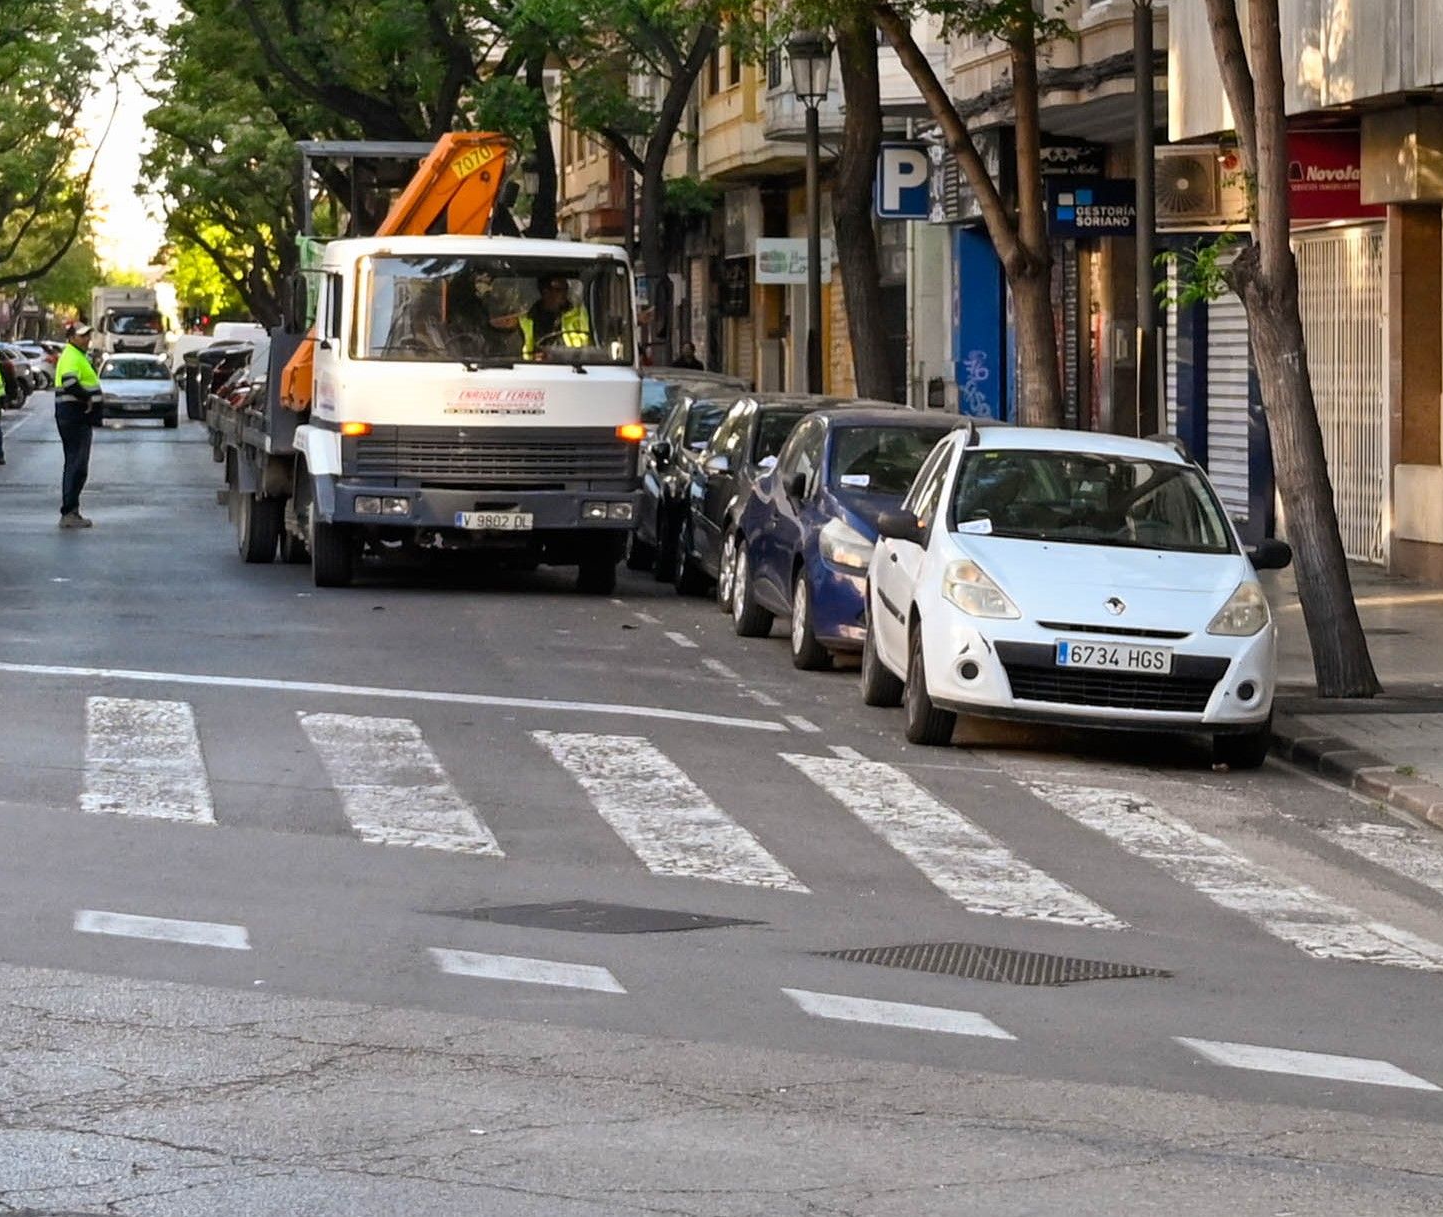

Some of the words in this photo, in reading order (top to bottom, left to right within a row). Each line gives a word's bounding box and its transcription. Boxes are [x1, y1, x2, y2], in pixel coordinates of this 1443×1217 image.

[453, 145, 491, 176] 7070
[883, 149, 928, 211] P
[1076, 204, 1136, 216] GESTORÍA
[1076, 216, 1130, 227] SORIANO
[477, 514, 510, 528] 9802
[1071, 645, 1120, 667] 6734
[1128, 649, 1165, 671] HGS
